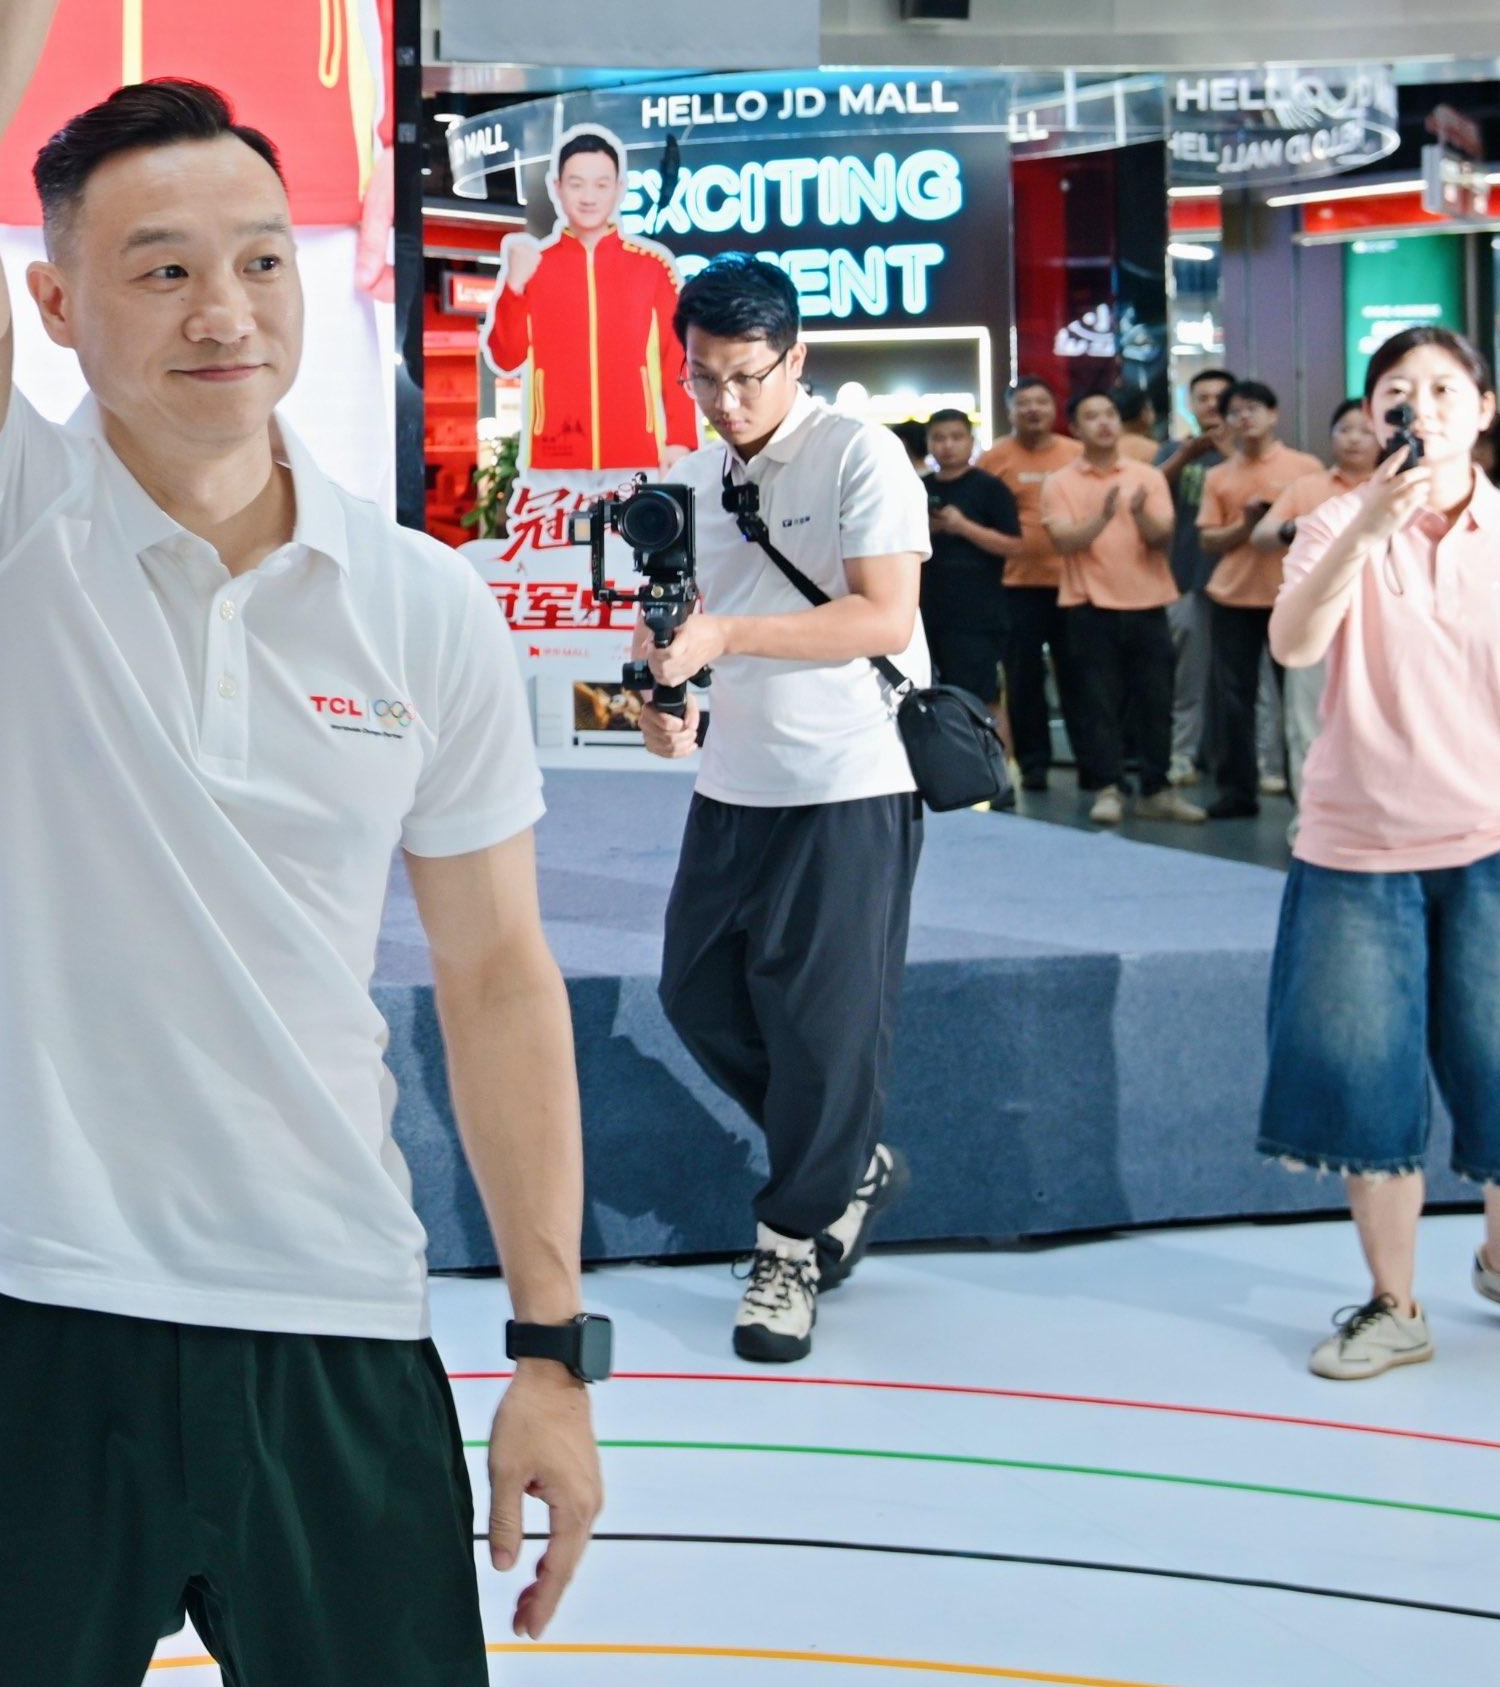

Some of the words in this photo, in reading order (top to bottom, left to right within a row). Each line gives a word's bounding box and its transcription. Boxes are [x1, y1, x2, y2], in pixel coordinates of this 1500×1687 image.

[641, 90, 769, 129] HELLO
[778, 90, 827, 121] JD
[838, 81, 960, 117] MALL
[619, 148, 962, 236] EXCITING
[310, 696, 363, 716] TCL
